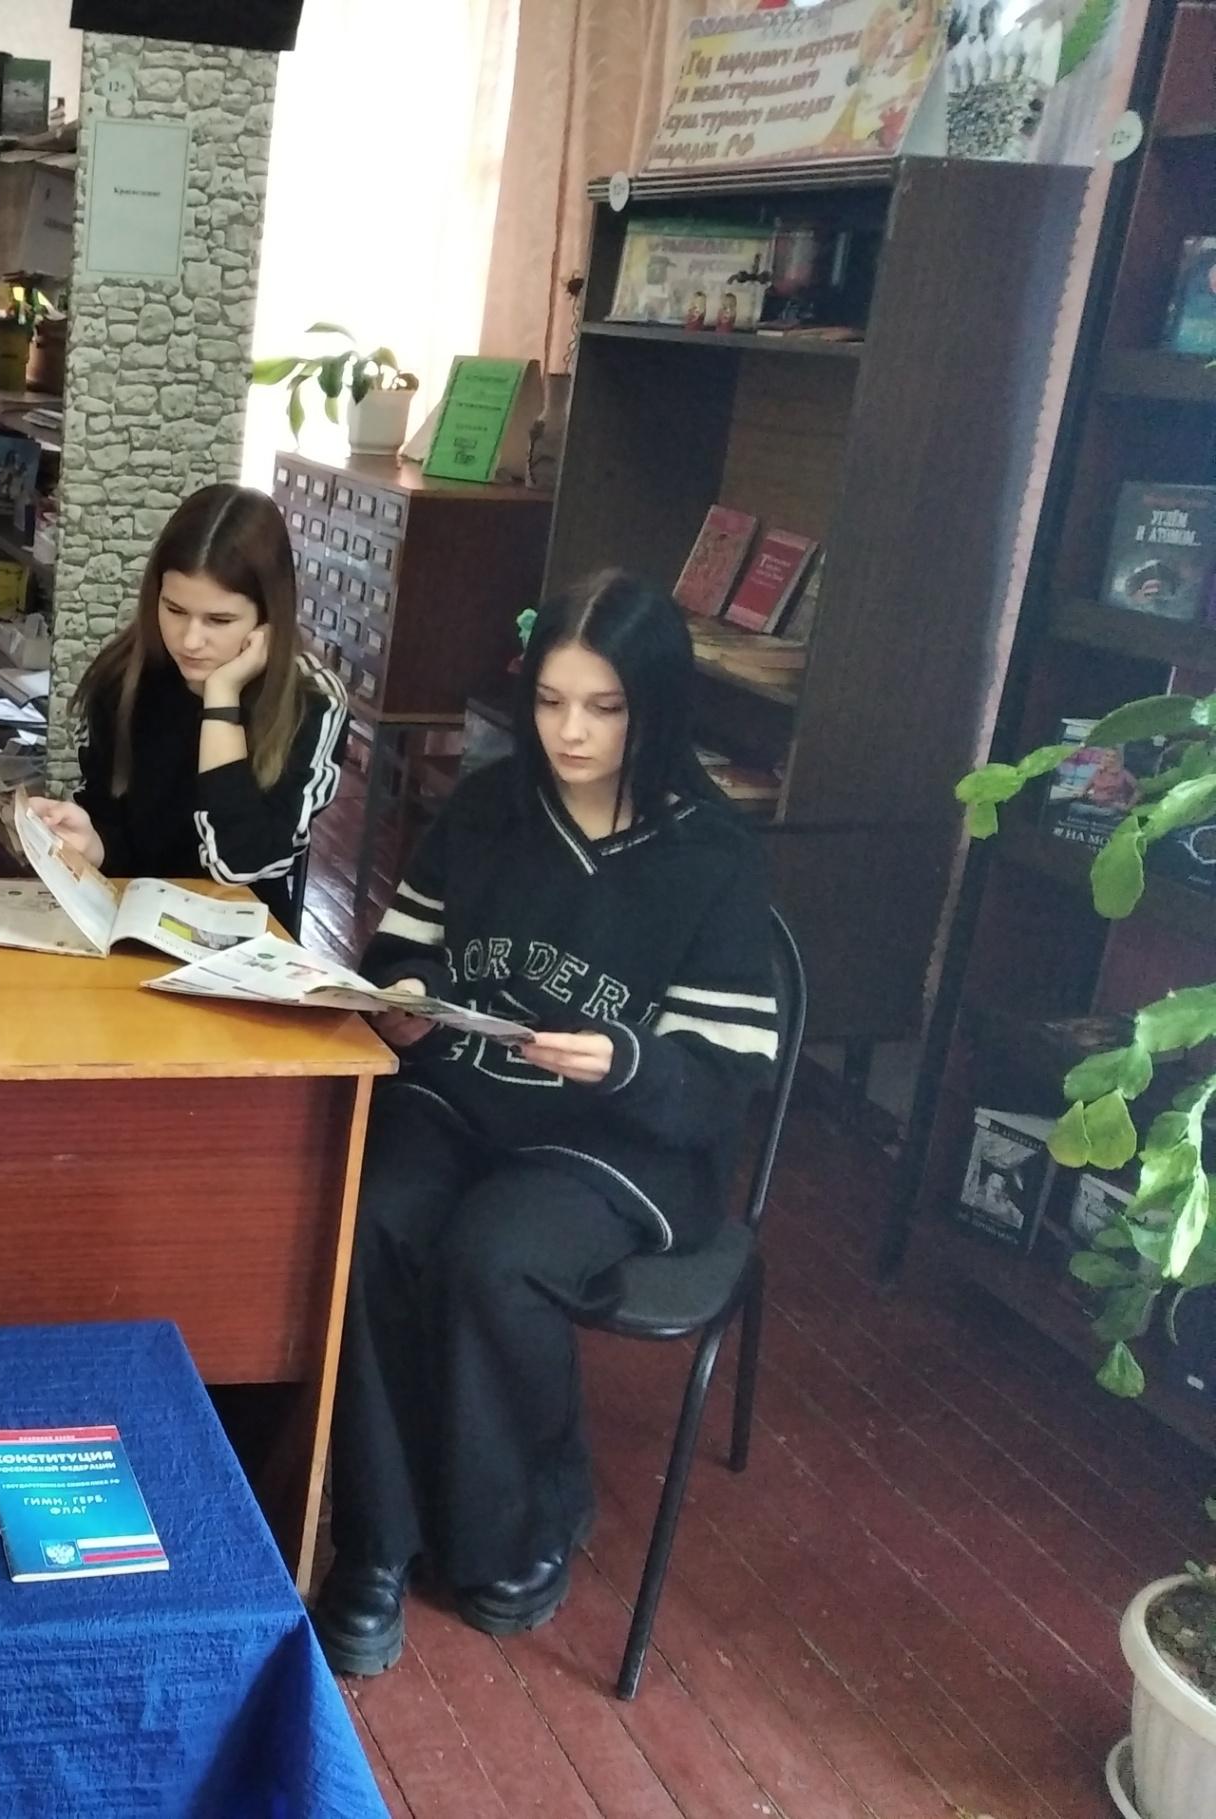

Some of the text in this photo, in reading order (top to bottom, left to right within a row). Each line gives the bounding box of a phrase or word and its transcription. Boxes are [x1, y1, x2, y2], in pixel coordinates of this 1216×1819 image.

[724, 132, 756, 158] РФ
[59, 1462, 117, 1472] ФЕДЕРАЦИИ
[24, 1494, 108, 1506] ГИМН, ГЕРБ,
[49, 1506, 87, 1515] ФЛАГ
